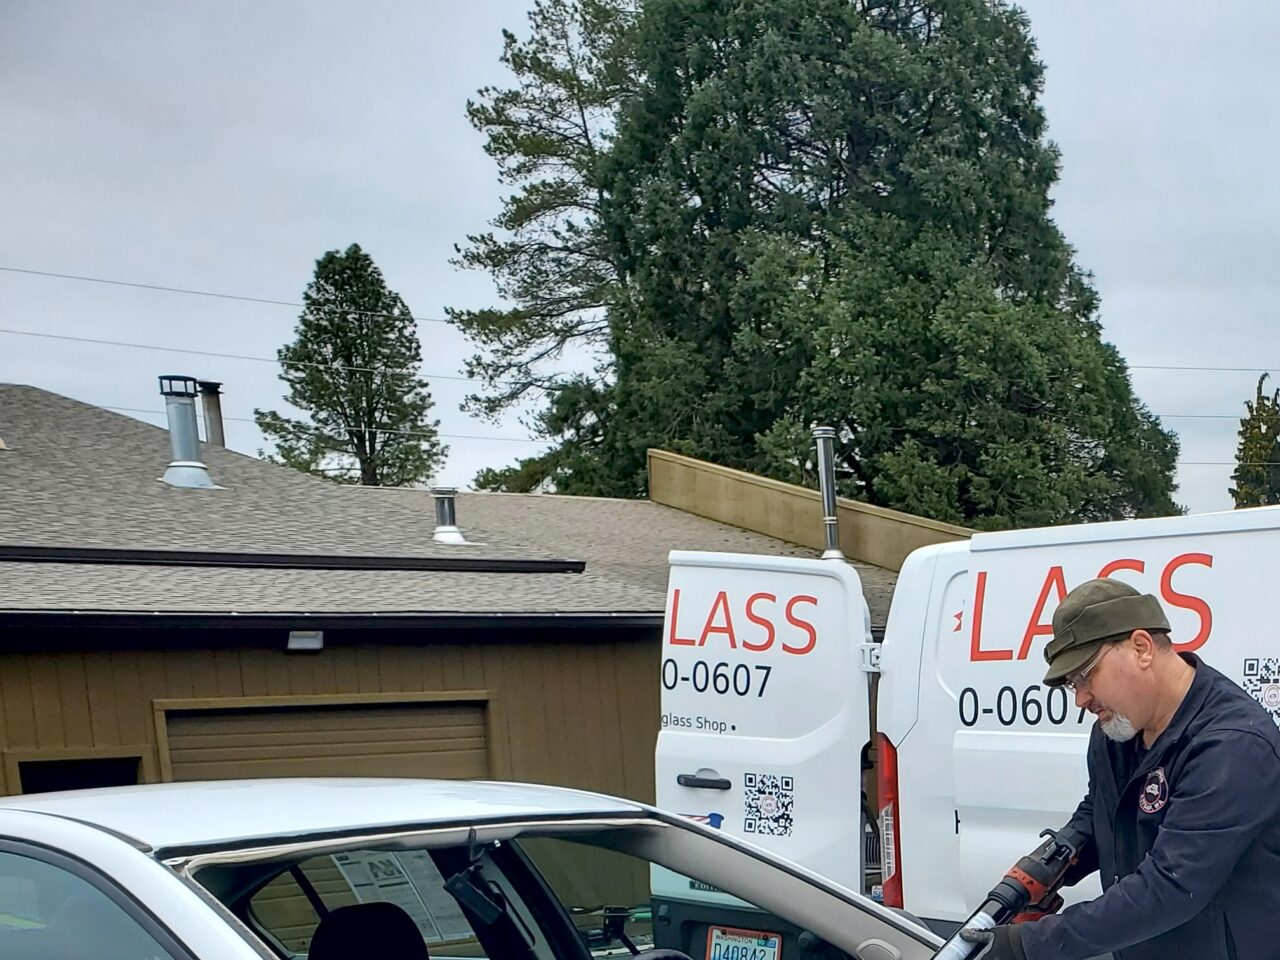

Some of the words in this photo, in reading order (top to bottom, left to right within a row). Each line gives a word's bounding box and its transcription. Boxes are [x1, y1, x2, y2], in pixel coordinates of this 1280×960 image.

[669, 589, 818, 655] LASS
[970, 552, 1213, 662] LAS
[662, 658, 772, 697] 0-0607
[661, 712, 692, 727] glass
[696, 716, 727, 734] Shop
[715, 934, 753, 944] WASHINGTON
